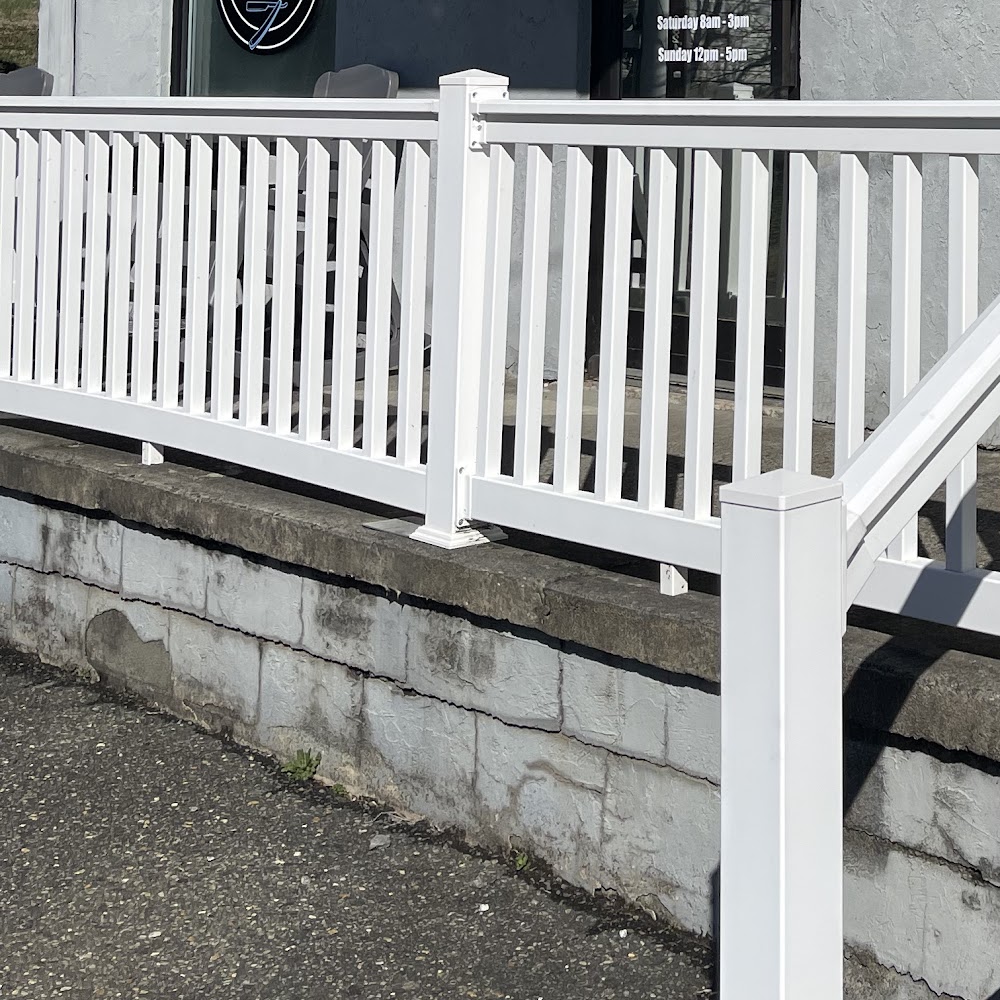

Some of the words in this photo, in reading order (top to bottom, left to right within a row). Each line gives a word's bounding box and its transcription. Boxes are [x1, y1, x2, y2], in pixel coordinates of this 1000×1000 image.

[657, 15, 699, 31] Saturday
[699, 14, 721, 29] 8am
[727, 13, 750, 30] 3pm
[658, 47, 692, 63] Sunday
[693, 47, 719, 63] 12pm
[725, 46, 748, 63] 5pm
